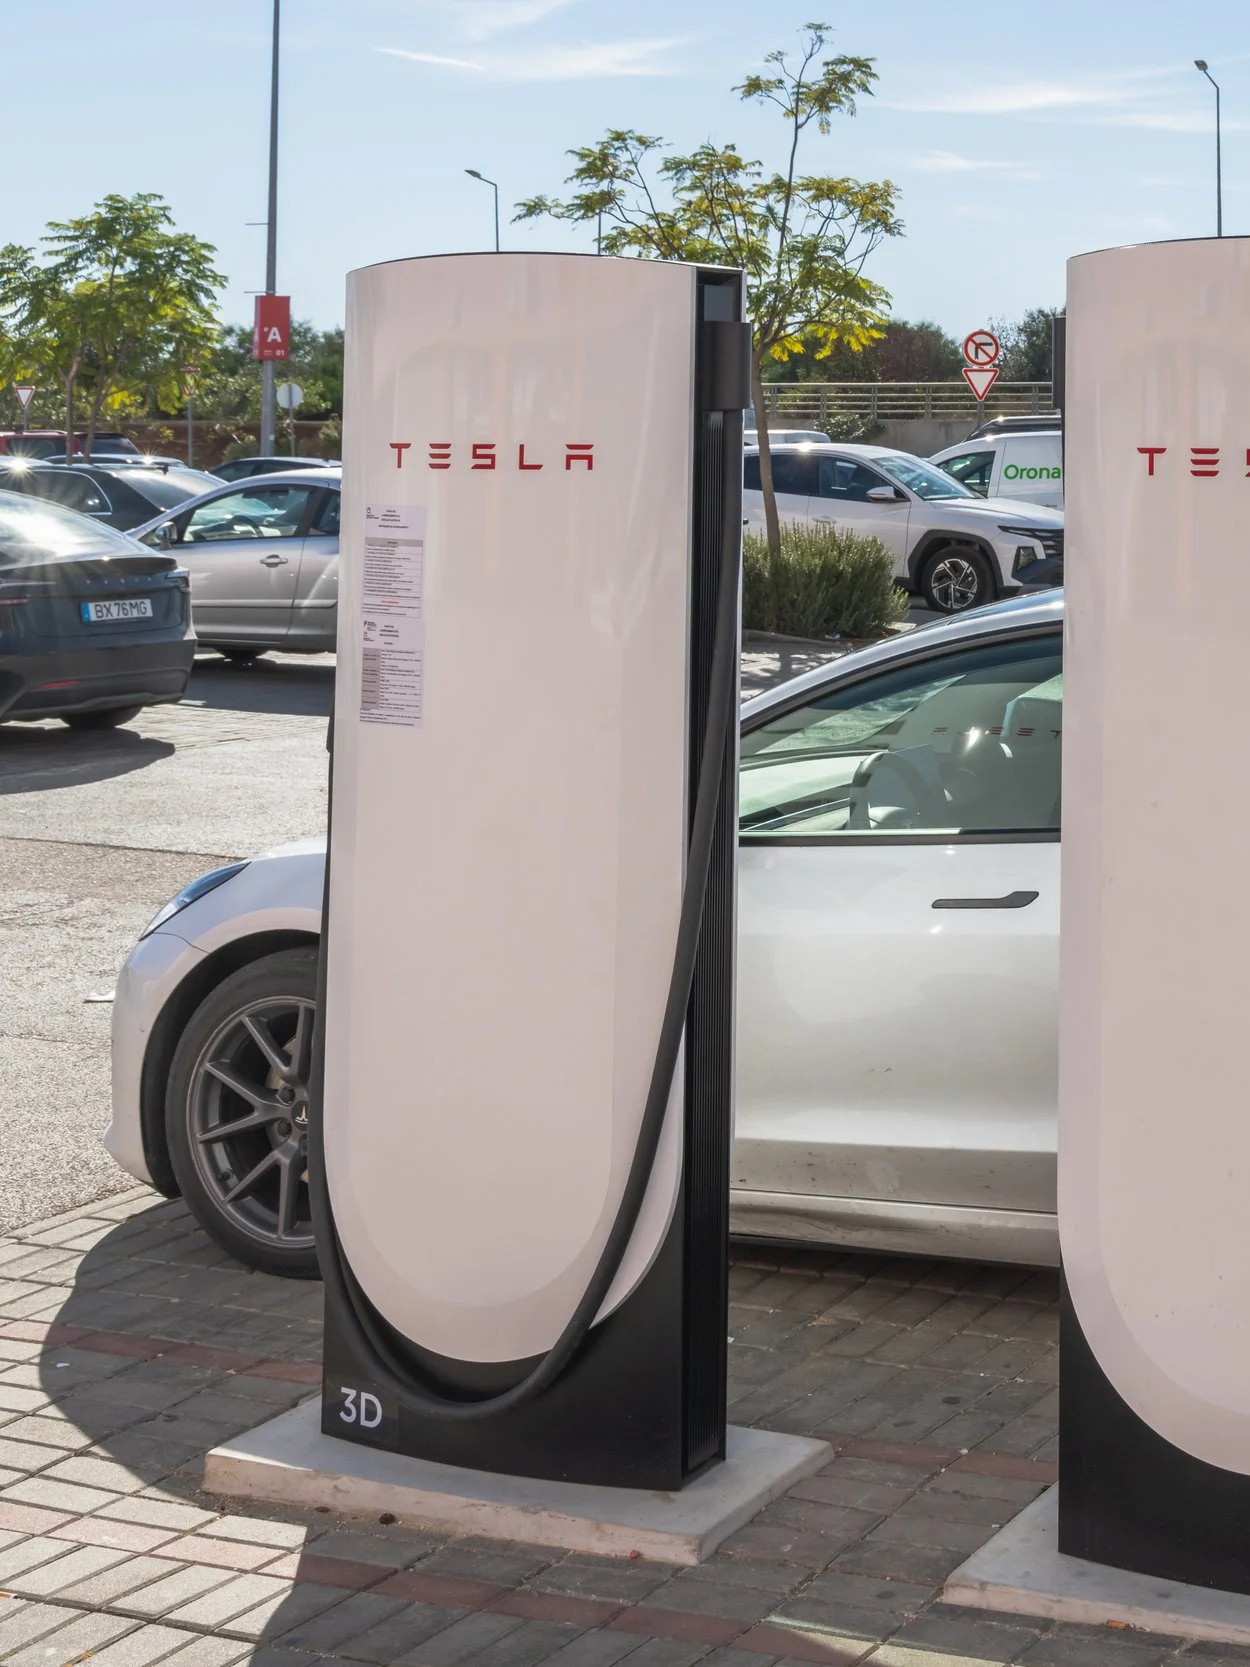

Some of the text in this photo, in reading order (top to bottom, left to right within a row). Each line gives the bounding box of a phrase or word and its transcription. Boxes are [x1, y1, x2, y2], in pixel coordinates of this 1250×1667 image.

[275, 349, 285, 357] 01
[389, 442, 594, 471] TESLA
[1004, 464, 1061, 480] Orona
[94, 601, 148, 619] BX76MG
[340, 1386, 383, 1428] 3D
